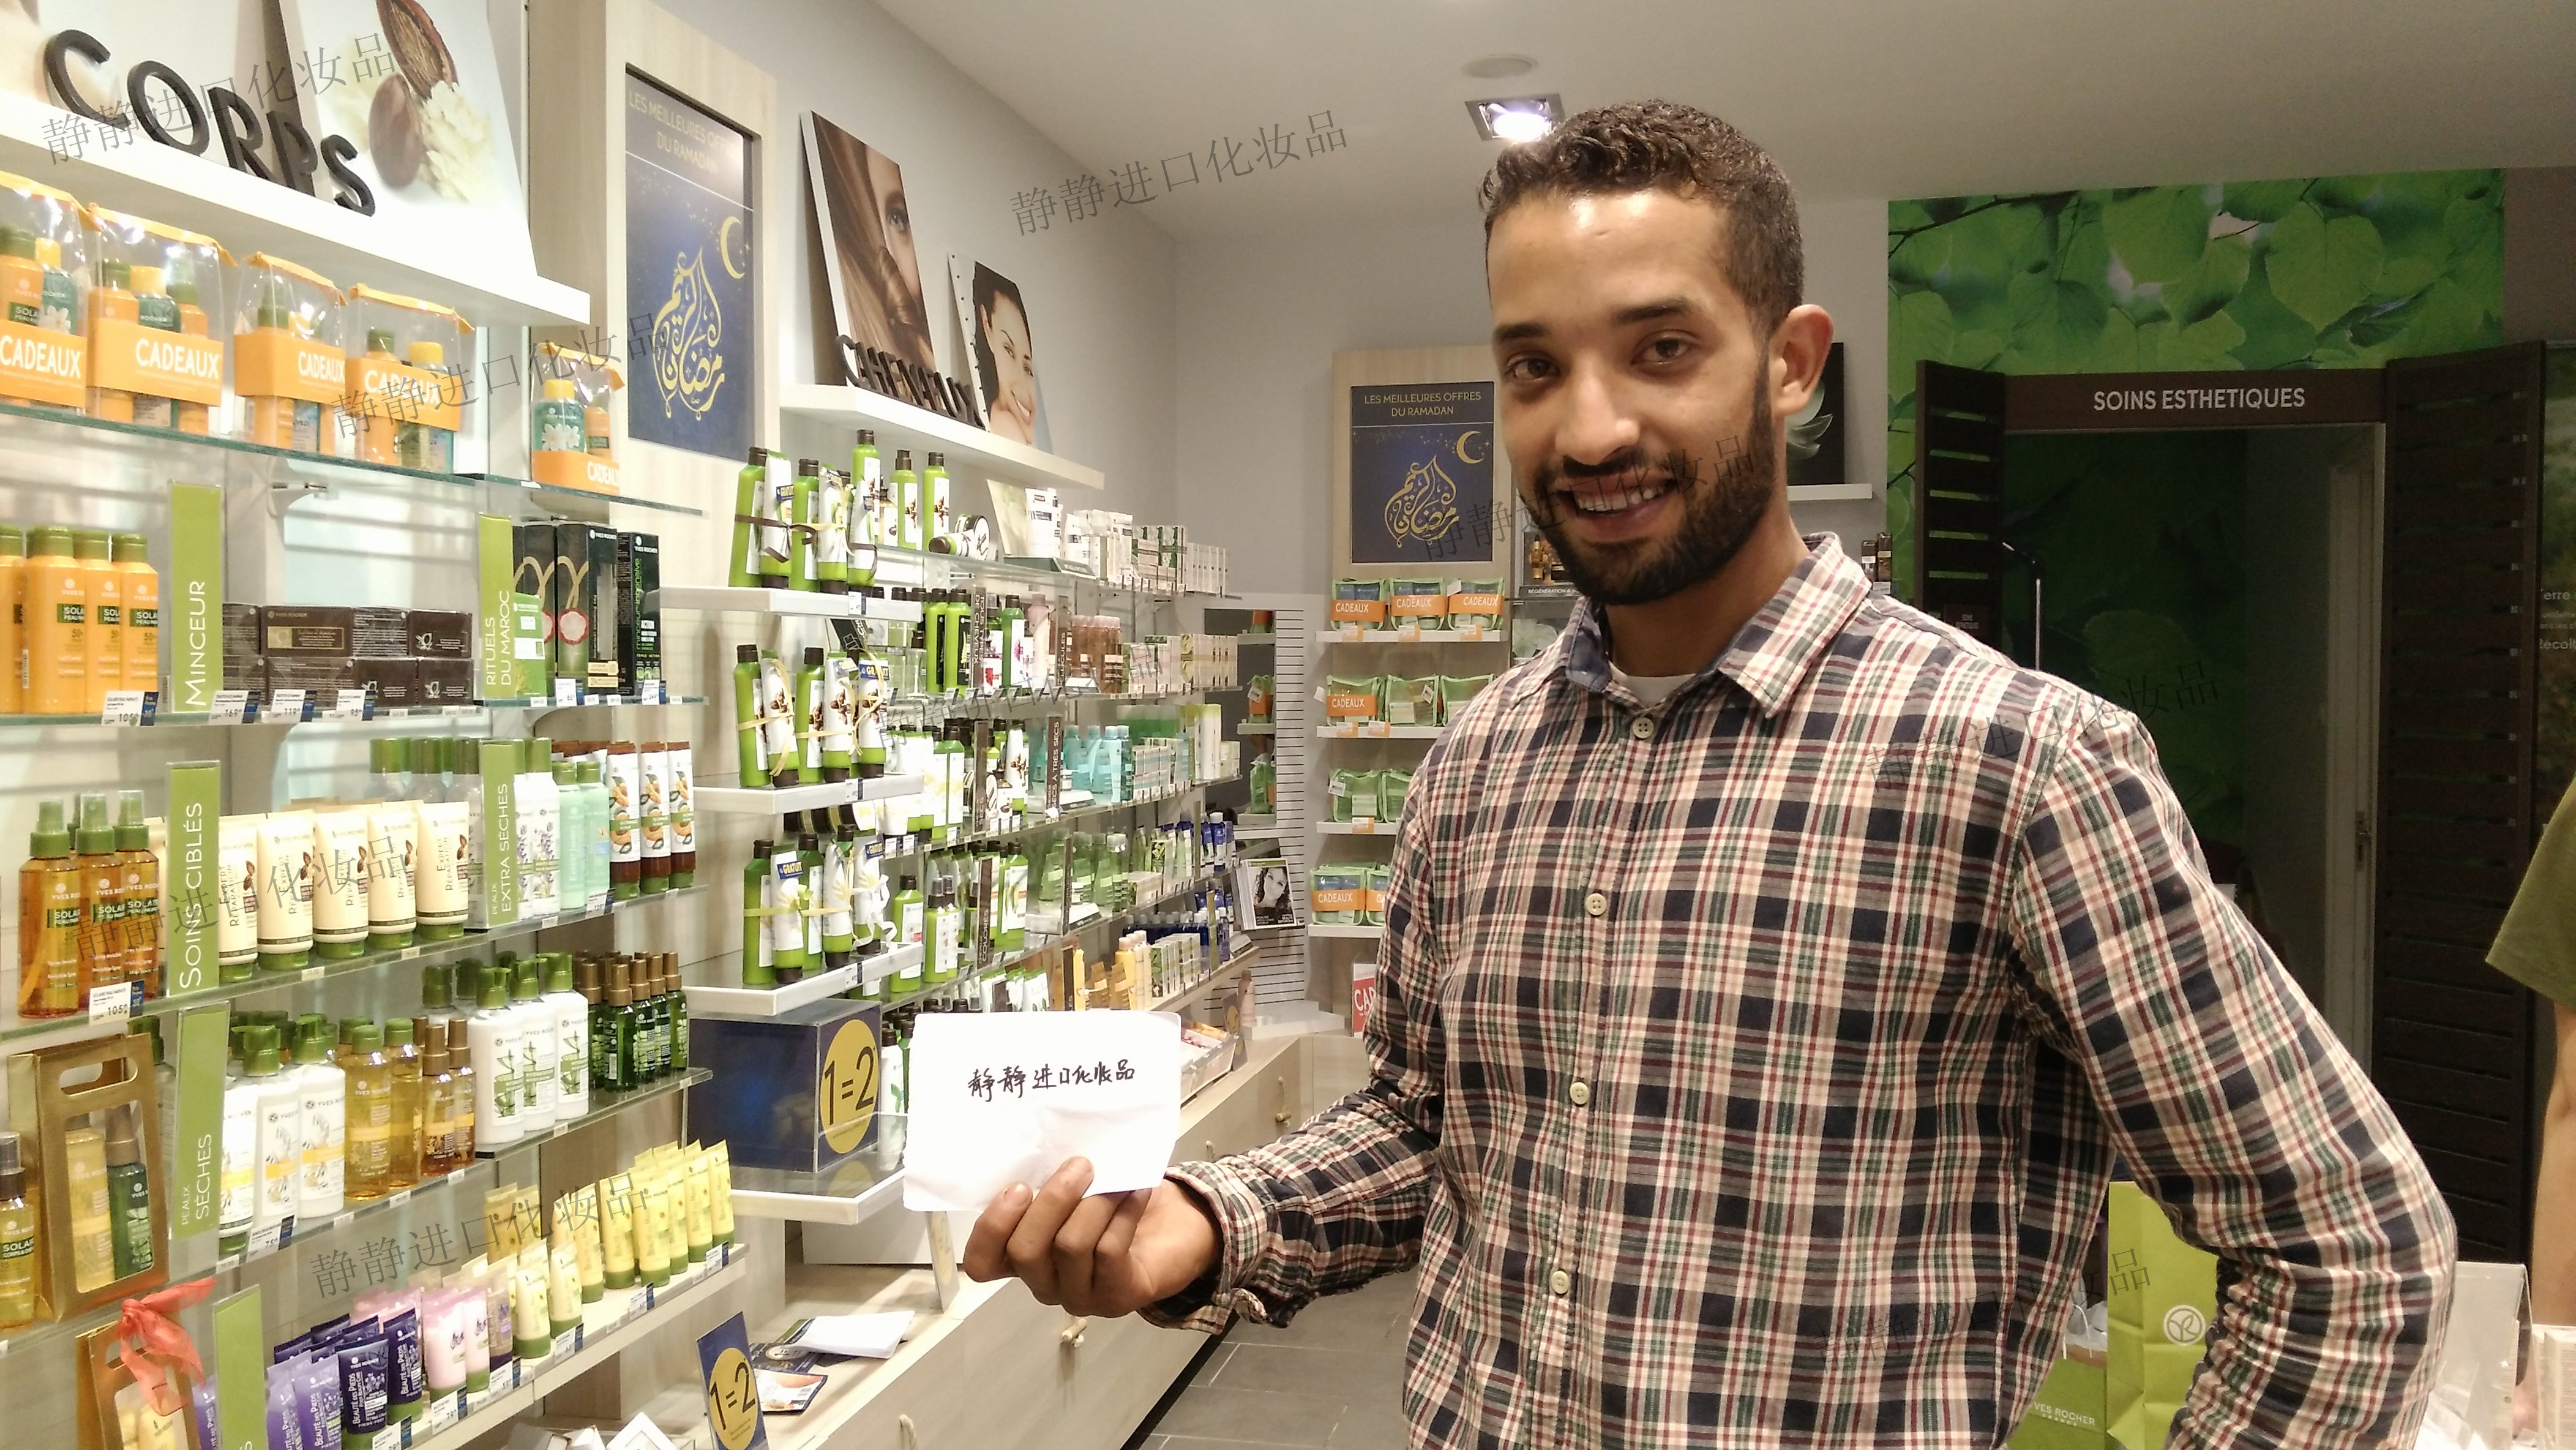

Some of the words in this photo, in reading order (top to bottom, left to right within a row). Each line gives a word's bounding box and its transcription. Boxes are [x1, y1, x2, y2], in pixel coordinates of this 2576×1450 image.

[657, 131, 672, 152] DU
[0, 335, 81, 379] CADEAUX
[135, 338, 219, 380] CADEAUX
[1364, 395, 1381, 405] LES
[1383, 393, 1441, 404] MEILLEURES
[1443, 391, 1481, 402] OFFRES
[2093, 389, 2157, 411] SOINS
[2162, 388, 2305, 410] ESTHETIQUES
[1391, 407, 1406, 417] DU
[1407, 405, 1454, 416] RAMADAN
[1396, 597, 1432, 608] CADEAUX
[1464, 596, 1498, 607] CADEAUX
[2540, 588, 2570, 600] erre
[1336, 602, 1369, 613] CADEAUX
[499, 590, 511, 655] MAROC
[185, 580, 206, 706] MINCEUR
[485, 617, 496, 686] RITUELS
[500, 663, 511, 686] DU
[1332, 697, 1365, 708] CADEAUX
[183, 802, 203, 891] CIBLÉS
[500, 858, 512, 912] EXTRA
[1318, 892, 1353, 904] CADEAUX
[179, 902, 202, 988] SOINS
[824, 1045, 875, 1125] 1=2
[182, 1185, 191, 1225] PEAUX
[710, 1361, 756, 1431] 1=2
[352, 1402, 361, 1425] BEAUTÉ
[2032, 1402, 2053, 1416] VES
[2054, 1408, 2096, 1426] ROCHER
